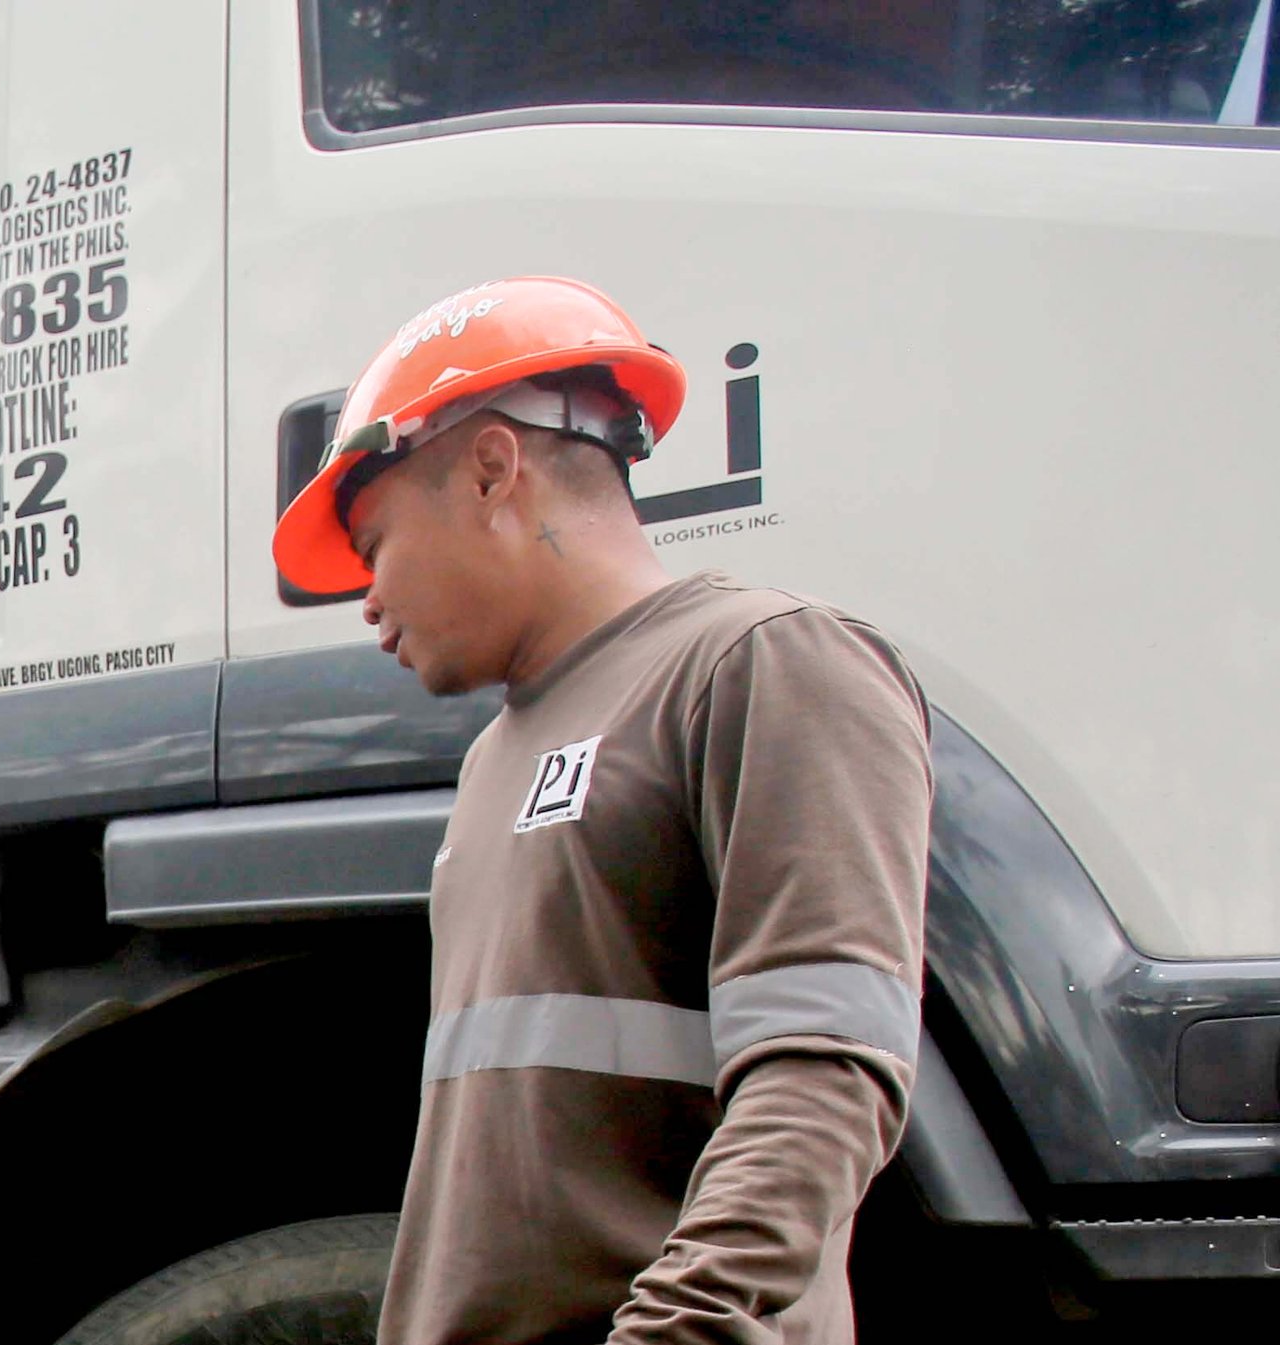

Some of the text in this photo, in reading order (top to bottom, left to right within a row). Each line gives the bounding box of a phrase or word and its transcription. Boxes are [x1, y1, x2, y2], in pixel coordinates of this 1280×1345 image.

[26, 149, 132, 203] 24-4837
[93, 185, 132, 219] INC.
[16, 246, 34, 275] IN
[39, 236, 68, 270] THE
[74, 221, 129, 261] PHILS.
[48, 337, 81, 380] FOR
[87, 326, 128, 375] HIRE
[63, 515, 80, 577] 3
[653, 512, 785, 547] LOGISTICS INC.
[21, 661, 54, 685] BRGY.
[58, 653, 101, 679] UGONG,
[106, 646, 143, 673] PASIG
[146, 642, 176, 666] CITY
